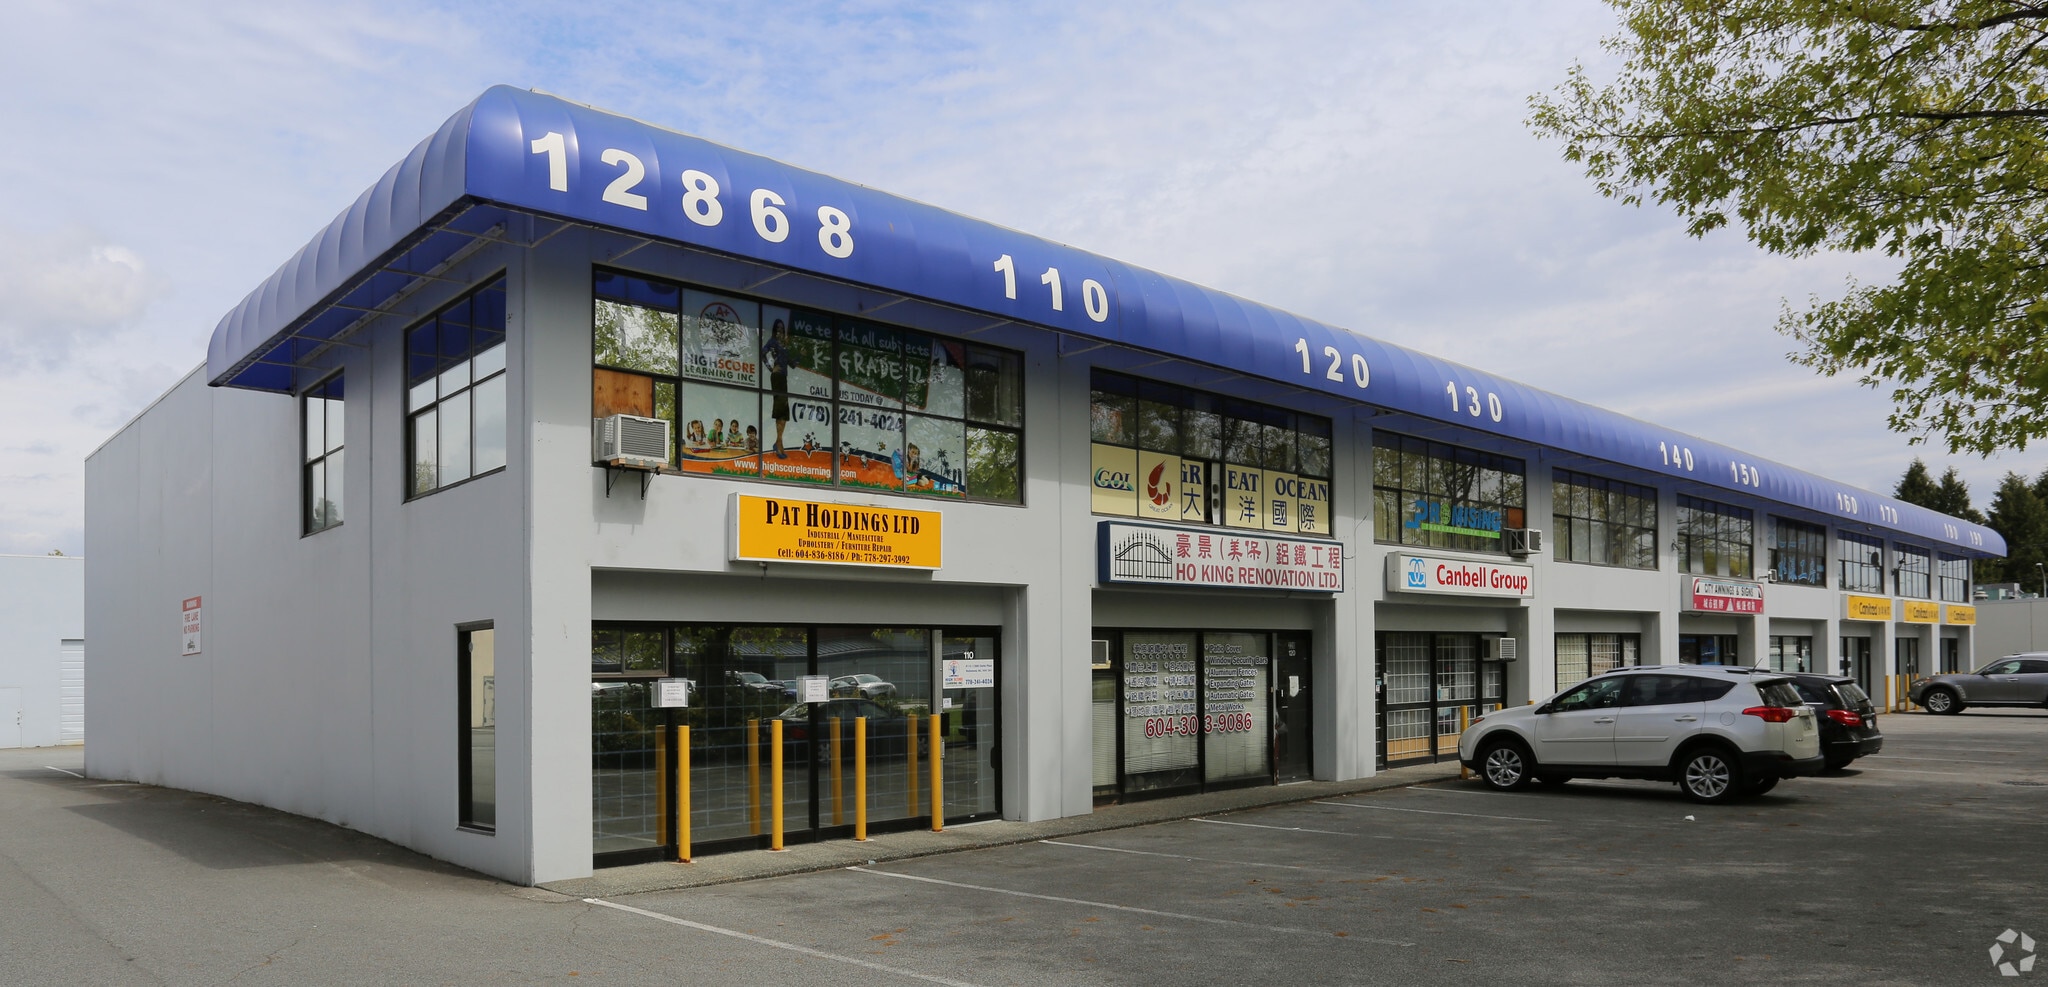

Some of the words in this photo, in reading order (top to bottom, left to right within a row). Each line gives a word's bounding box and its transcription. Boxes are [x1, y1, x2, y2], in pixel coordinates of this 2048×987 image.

[531, 131, 854, 259] 12868
[994, 253, 1109, 323] 110
[716, 305, 730, 317] A+
[794, 320, 813, 335] We
[861, 330, 876, 349] all
[684, 364, 734, 379] LEARNING
[737, 372, 756, 382] INC.
[1295, 337, 1370, 389] 120
[809, 385, 830, 398] CALL
[839, 390, 849, 400] US
[850, 391, 875, 404] TODAY
[1446, 380, 1503, 423] 130
[791, 402, 831, 426] (778)
[839, 407, 904, 433] 241-4024
[1659, 441, 1694, 472] 140
[1731, 460, 1760, 488] 150
[1274, 477, 1328, 502] OCEAN
[1837, 492, 1858, 515] 160
[1879, 504, 1898, 525] 170
[766, 500, 801, 526] PAT
[806, 503, 889, 533] HOLDINGS
[893, 514, 920, 535] LTD
[798, 538, 834, 550] UPHOLSTERY
[841, 541, 871, 551] FURNITURE
[872, 543, 892, 553] REPAIR
[807, 528, 840, 540] INDUSTRIAL
[847, 531, 884, 543] MANUFACTURE
[777, 547, 794, 558] Cell:
[795, 549, 845, 561] 604-836-8186
[851, 552, 863, 562] Ph:
[864, 553, 910, 564] 778-297-3992
[1176, 562, 1197, 582] HO
[1201, 564, 1235, 584] KING
[1238, 566, 1315, 588] RENOVATION
[1318, 572, 1341, 589] LTD.
[1436, 564, 1487, 588] Canbell
[1490, 568, 1528, 595] Group
[963, 651, 974, 660] 110
[1209, 656, 1232, 665] Window
[1232, 656, 1255, 667] Security
[1208, 668, 1238, 677] Aluminum
[1238, 668, 1258, 677] Fences
[1209, 679, 1239, 690] Expanding
[1239, 678, 1256, 688] Gates
[1209, 691, 1239, 701] Automatic
[1239, 690, 1256, 700] Gates
[1209, 702, 1227, 712] Metal
[1227, 702, 1245, 711] Works
[1145, 712, 1253, 739] 604-303-9086
